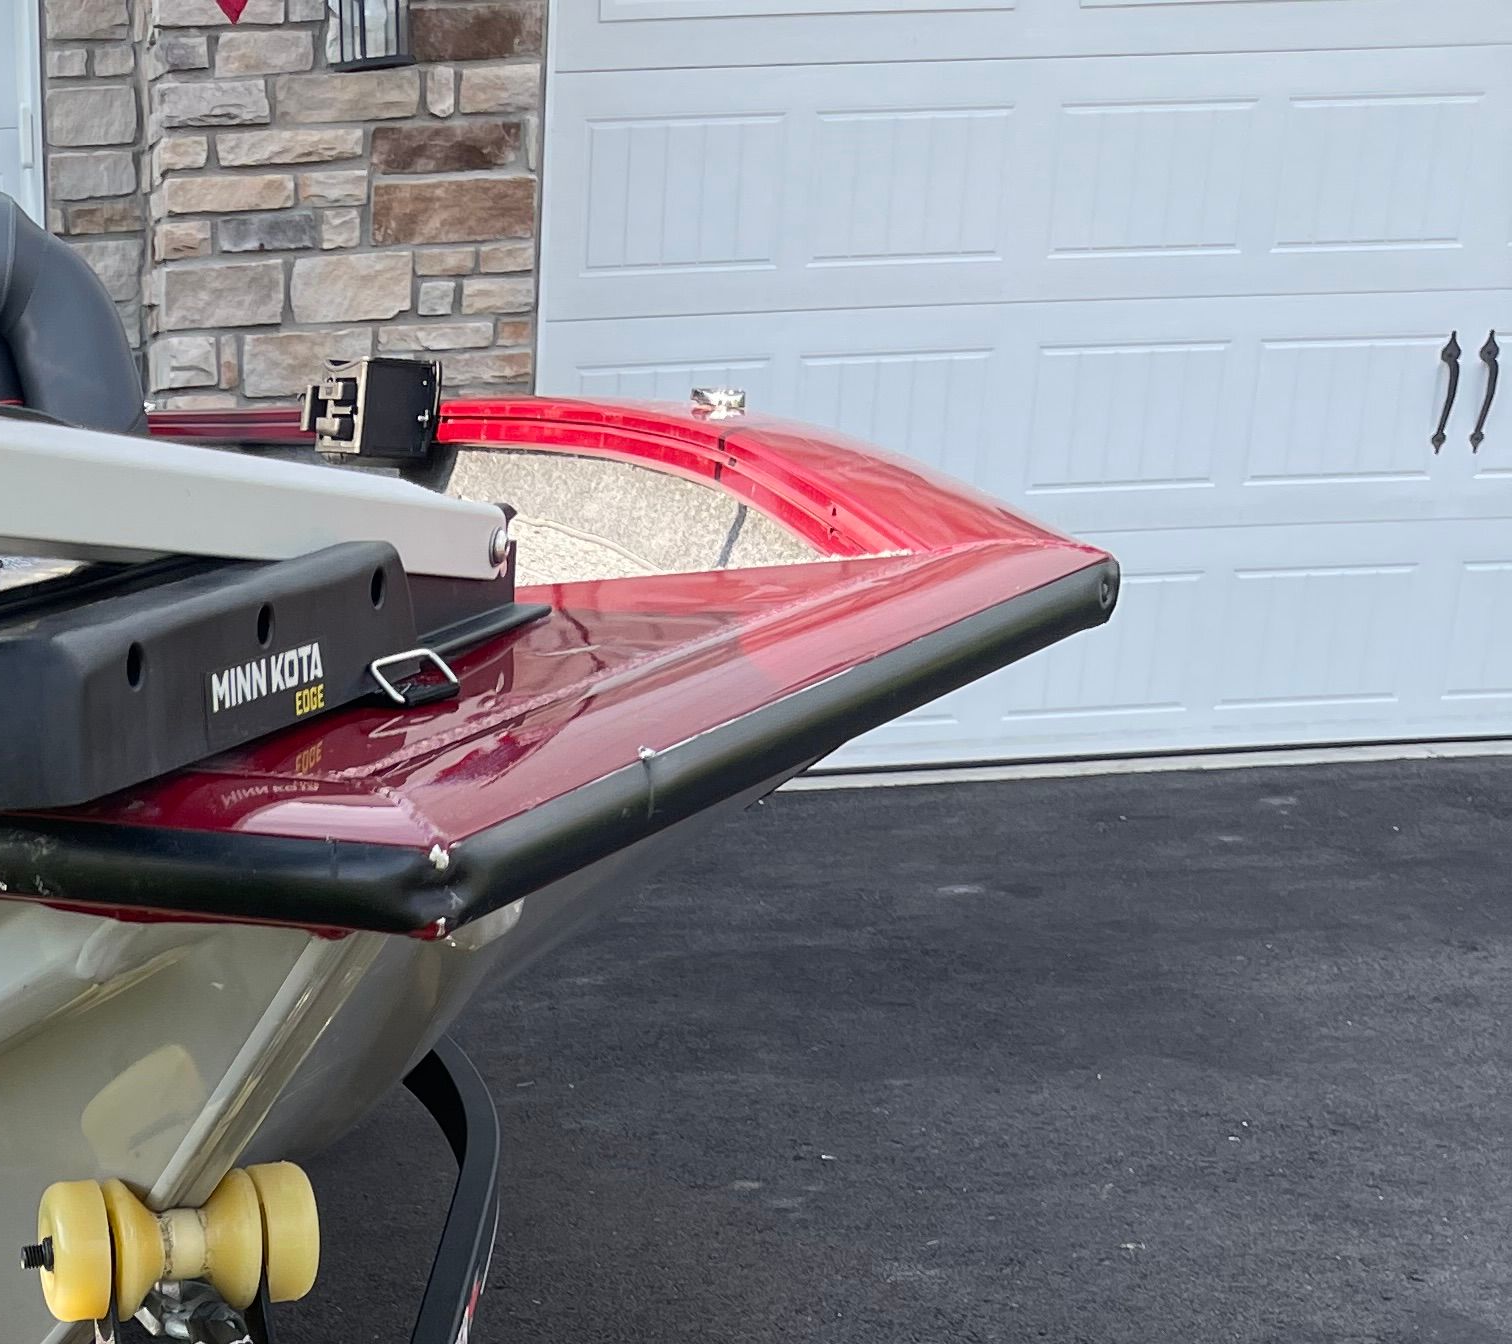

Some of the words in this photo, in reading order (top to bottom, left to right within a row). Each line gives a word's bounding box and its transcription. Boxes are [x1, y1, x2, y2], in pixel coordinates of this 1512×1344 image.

[211, 658, 268, 713] MINN
[270, 641, 324, 693] KOTA
[295, 683, 325, 716] EDGE
